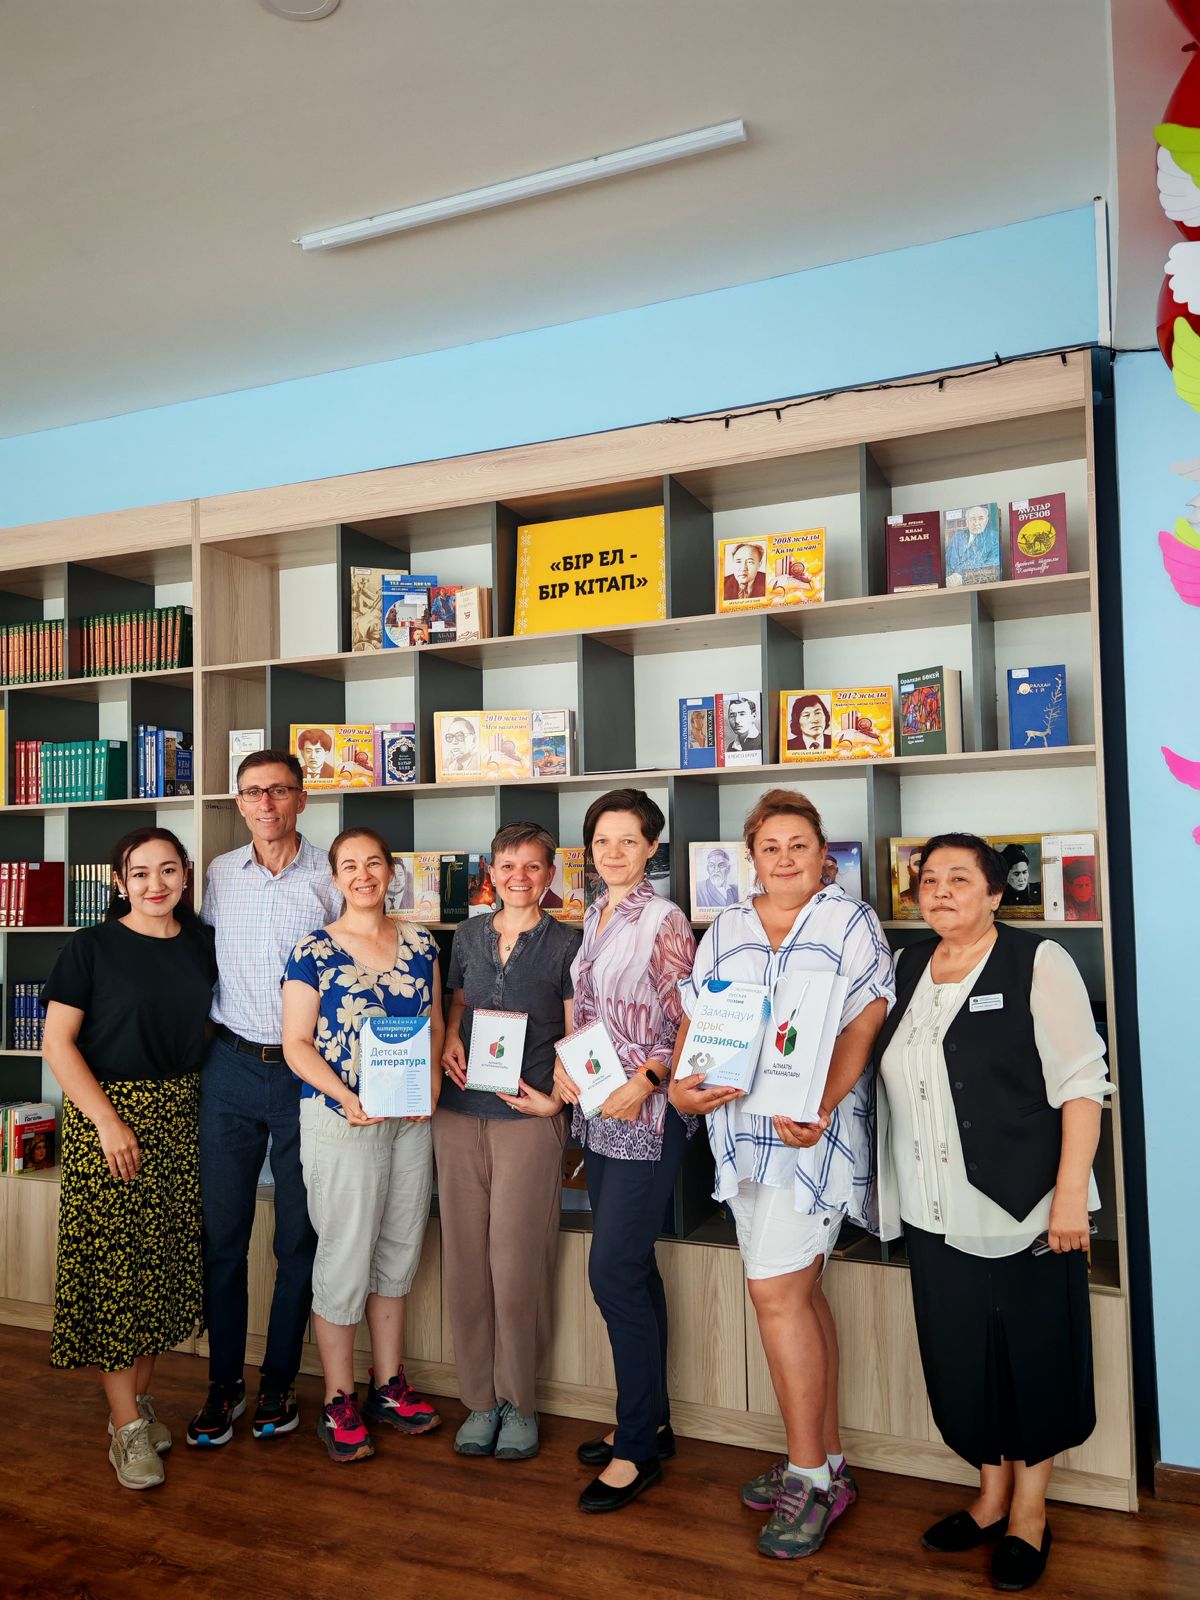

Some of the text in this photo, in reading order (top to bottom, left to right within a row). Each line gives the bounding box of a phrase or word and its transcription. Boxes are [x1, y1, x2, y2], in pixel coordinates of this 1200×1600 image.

[899, 534, 930, 543] ЗАМАН
[550, 553, 594, 571] «БІР
[599, 548, 625, 567] ЕЛ
[538, 574, 648, 600] БІР КІТАП»
[837, 692, 858, 700] 2012
[700, 1005, 754, 1022] Заманауи
[696, 1021, 725, 1032] орыс
[692, 1034, 749, 1050] поэзиясы
[370, 1047, 408, 1057] Детская
[370, 1058, 426, 1068] литература
